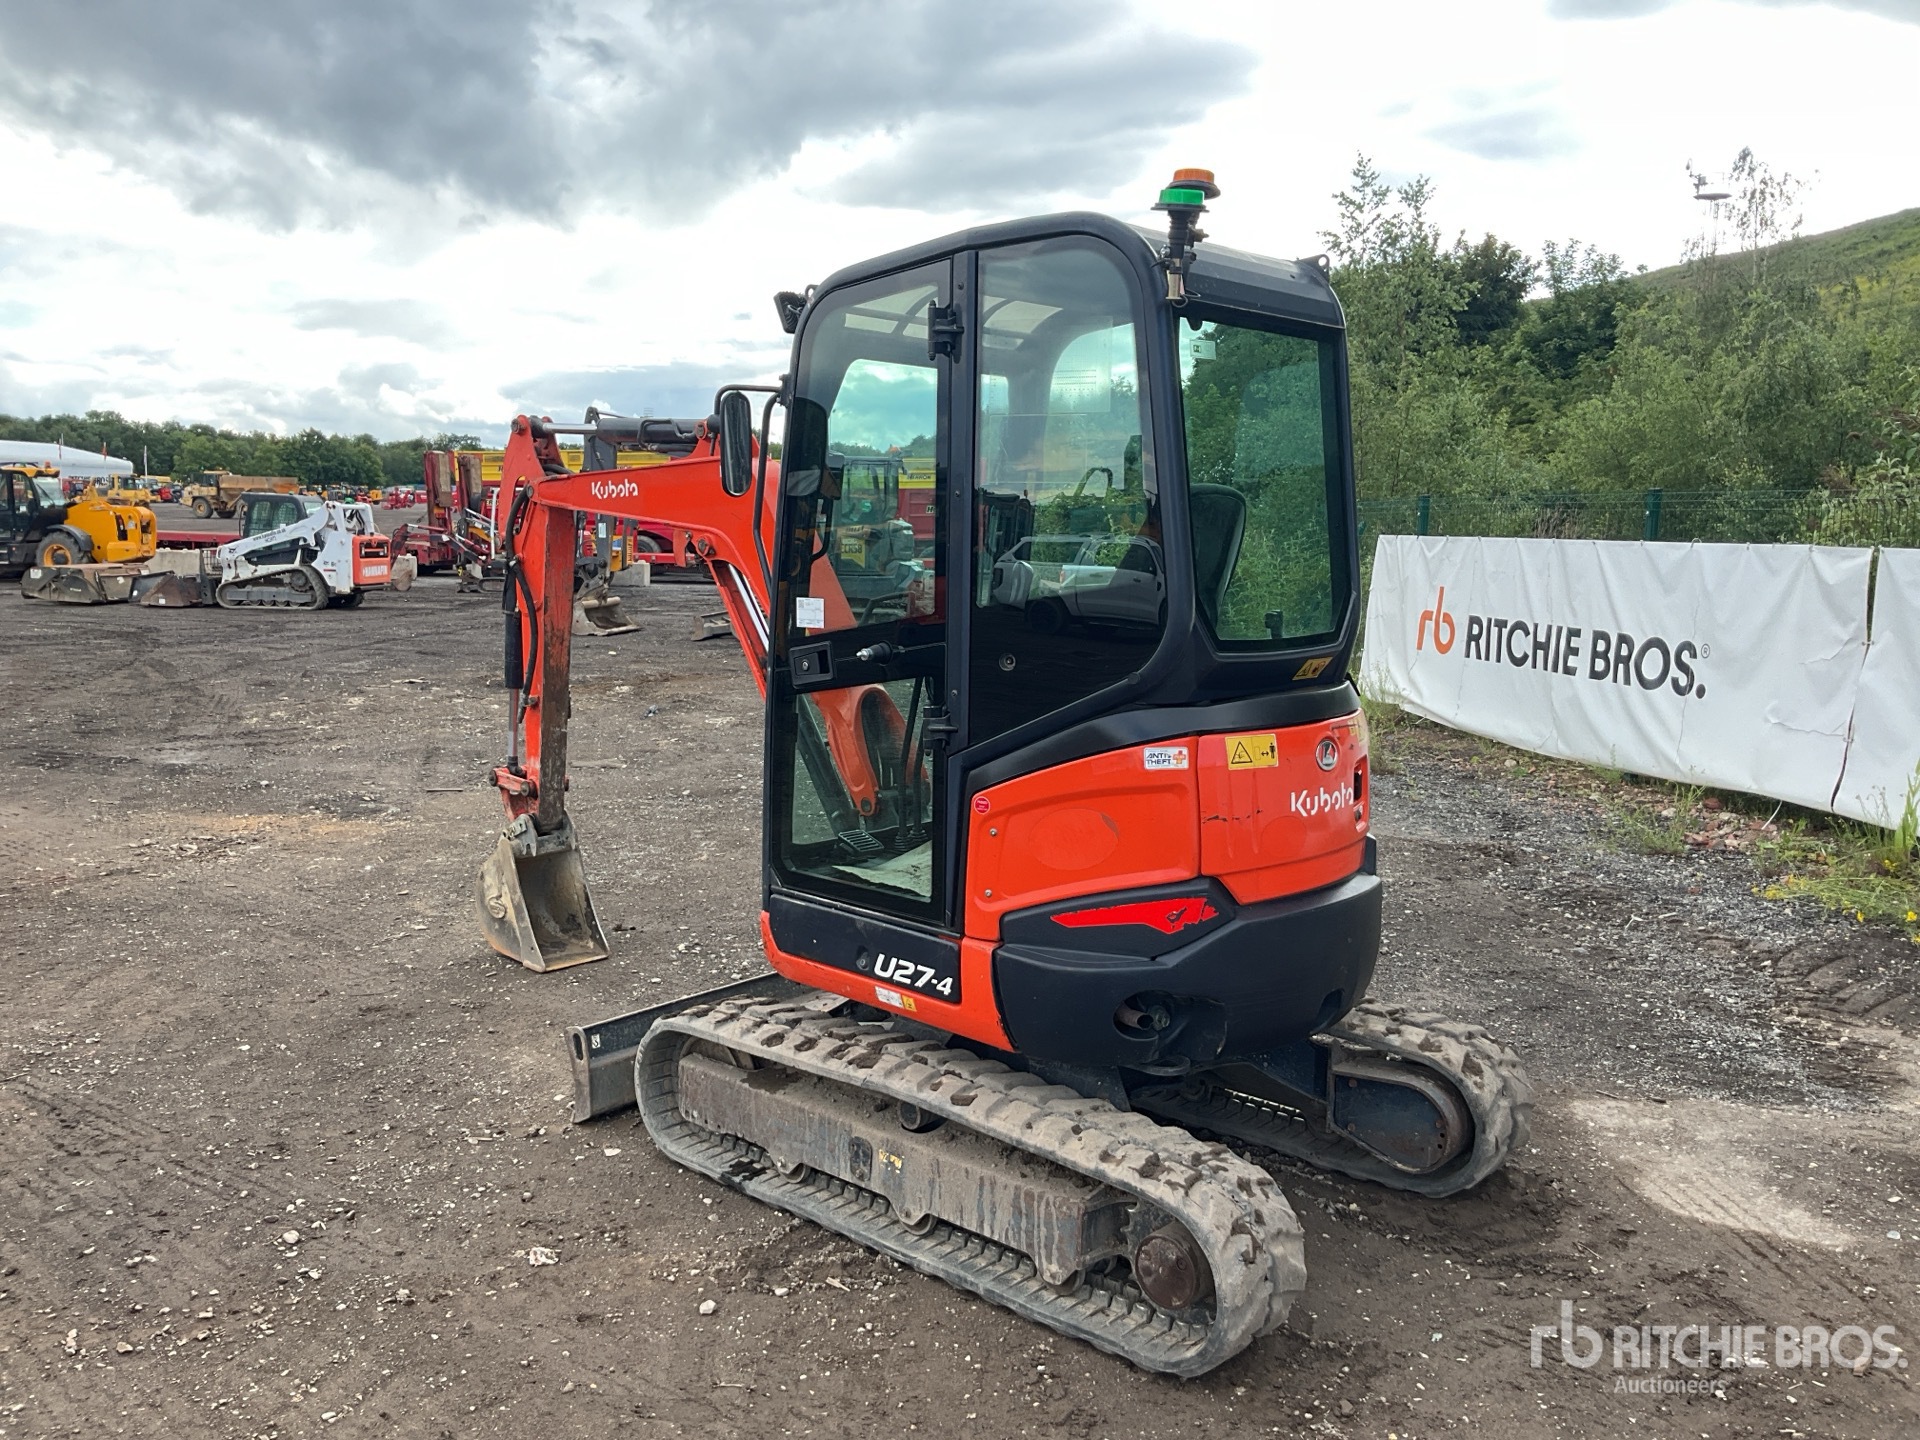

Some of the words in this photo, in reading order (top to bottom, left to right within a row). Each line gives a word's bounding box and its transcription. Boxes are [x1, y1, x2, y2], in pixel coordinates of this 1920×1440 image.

[591, 479, 638, 499] Kubota
[1464, 614, 1582, 676] RITCHIE
[1290, 782, 1354, 817] Kubota
[874, 953, 953, 996] U27-4
